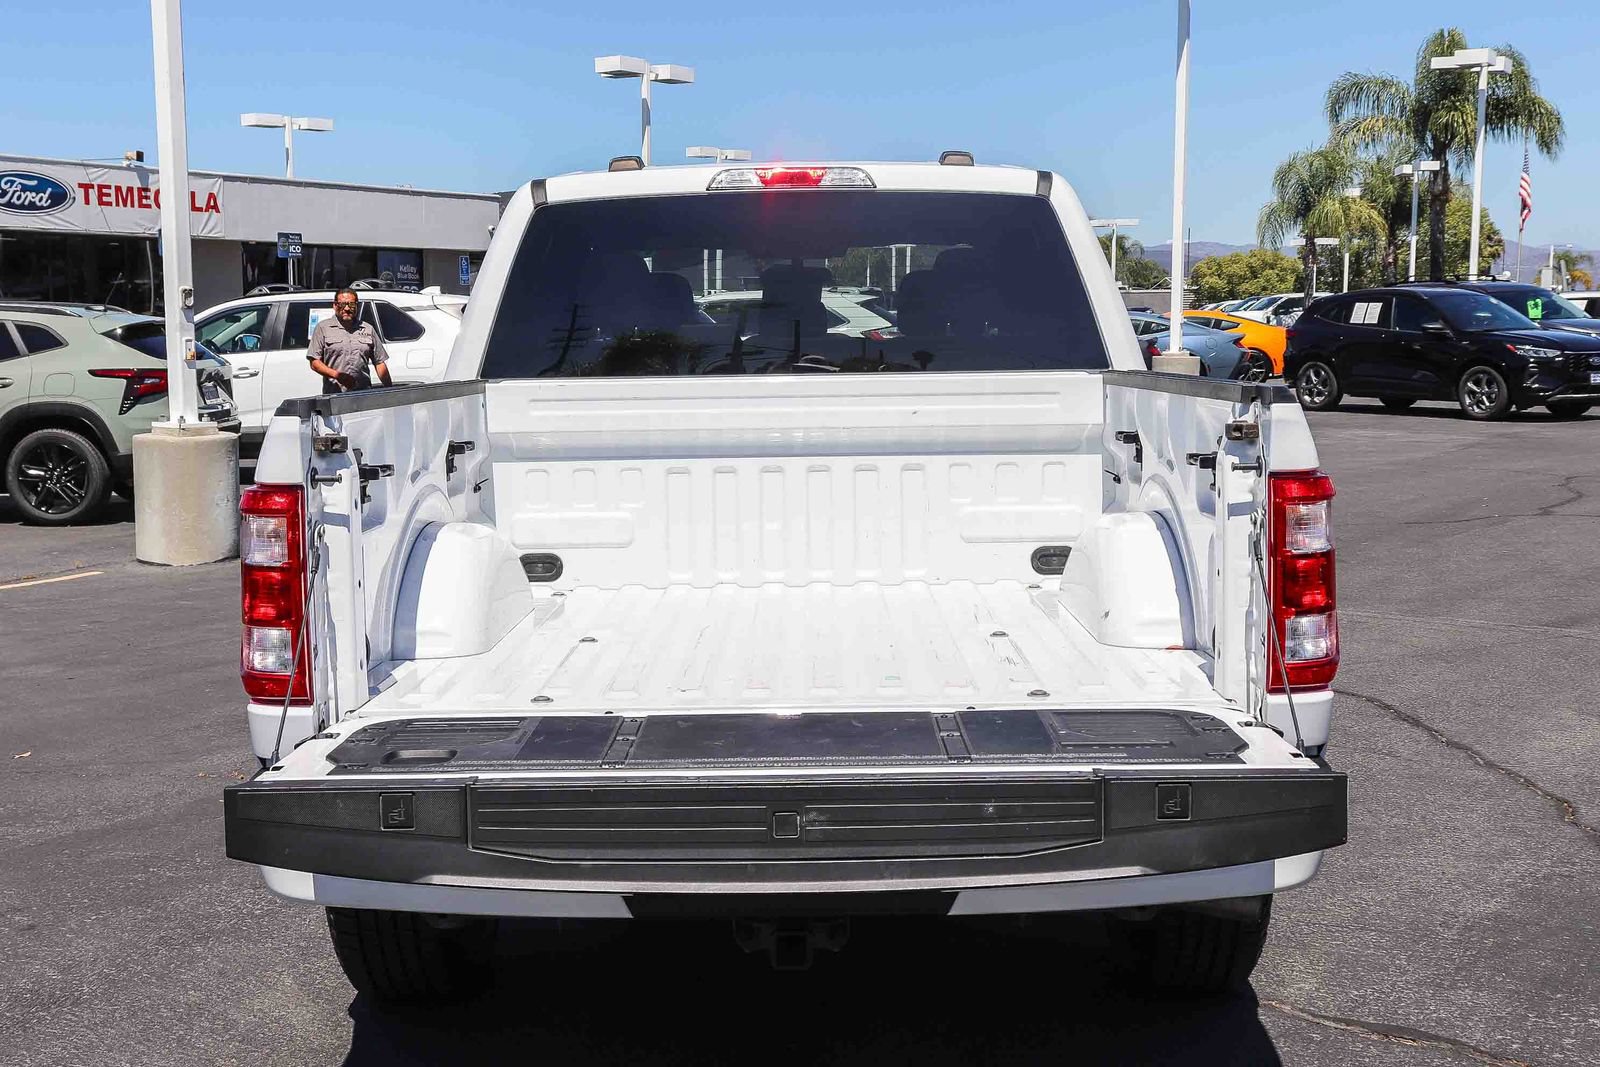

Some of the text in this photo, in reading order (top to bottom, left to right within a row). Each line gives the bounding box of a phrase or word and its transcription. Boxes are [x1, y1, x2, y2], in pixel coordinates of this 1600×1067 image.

[0, 177, 221, 214] Ford TEMELA
[289, 245, 302, 253] ICO
[399, 264, 417, 274] Kelley
